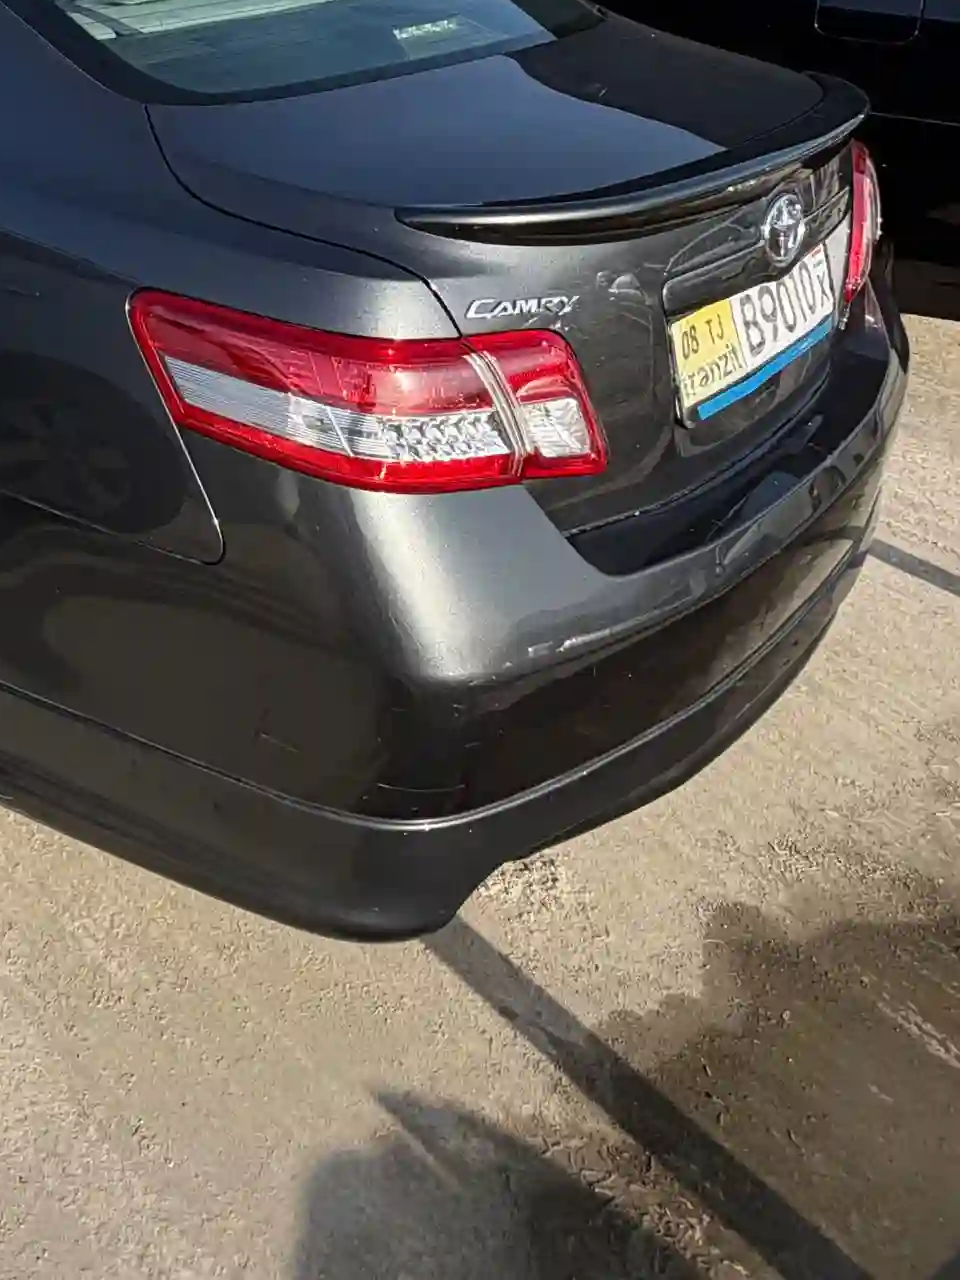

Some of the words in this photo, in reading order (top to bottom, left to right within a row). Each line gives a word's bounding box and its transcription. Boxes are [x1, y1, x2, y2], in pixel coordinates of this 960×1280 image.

[464, 295, 580, 319] CAMRY
[681, 323, 700, 361] 08
[707, 313, 725, 345] TJ
